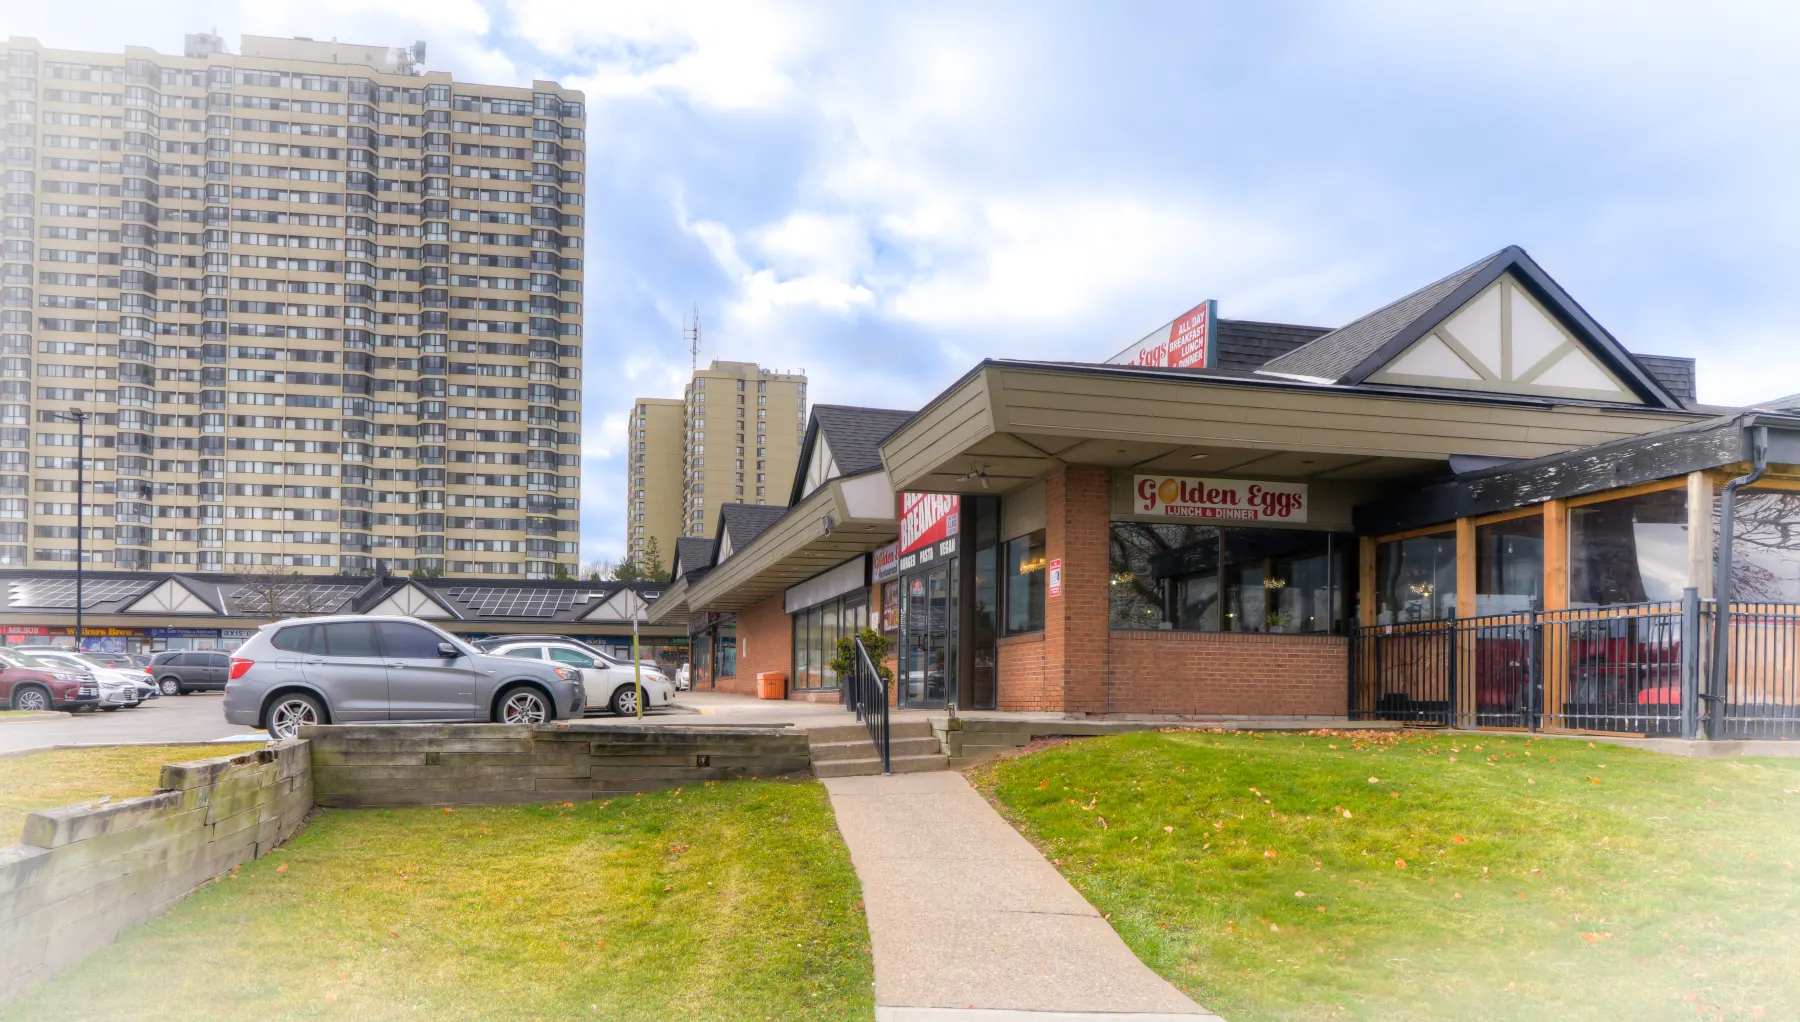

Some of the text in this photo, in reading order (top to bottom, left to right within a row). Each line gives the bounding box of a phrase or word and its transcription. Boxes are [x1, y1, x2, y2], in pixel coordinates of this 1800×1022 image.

[1178, 311, 1205, 336] ALL DAY
[1169, 323, 1205, 353] BREAKFAST
[1181, 336, 1204, 358] LUNCH
[1178, 348, 1203, 368] DINNER
[1247, 484, 1303, 518] Eggs
[1167, 506, 1256, 520] LUNCH & DINNER
[900, 554, 915, 571] BURGER
[920, 547, 933, 564] PASTA
[940, 538, 955, 556] VEGAN
[108, 627, 133, 636] Brew
